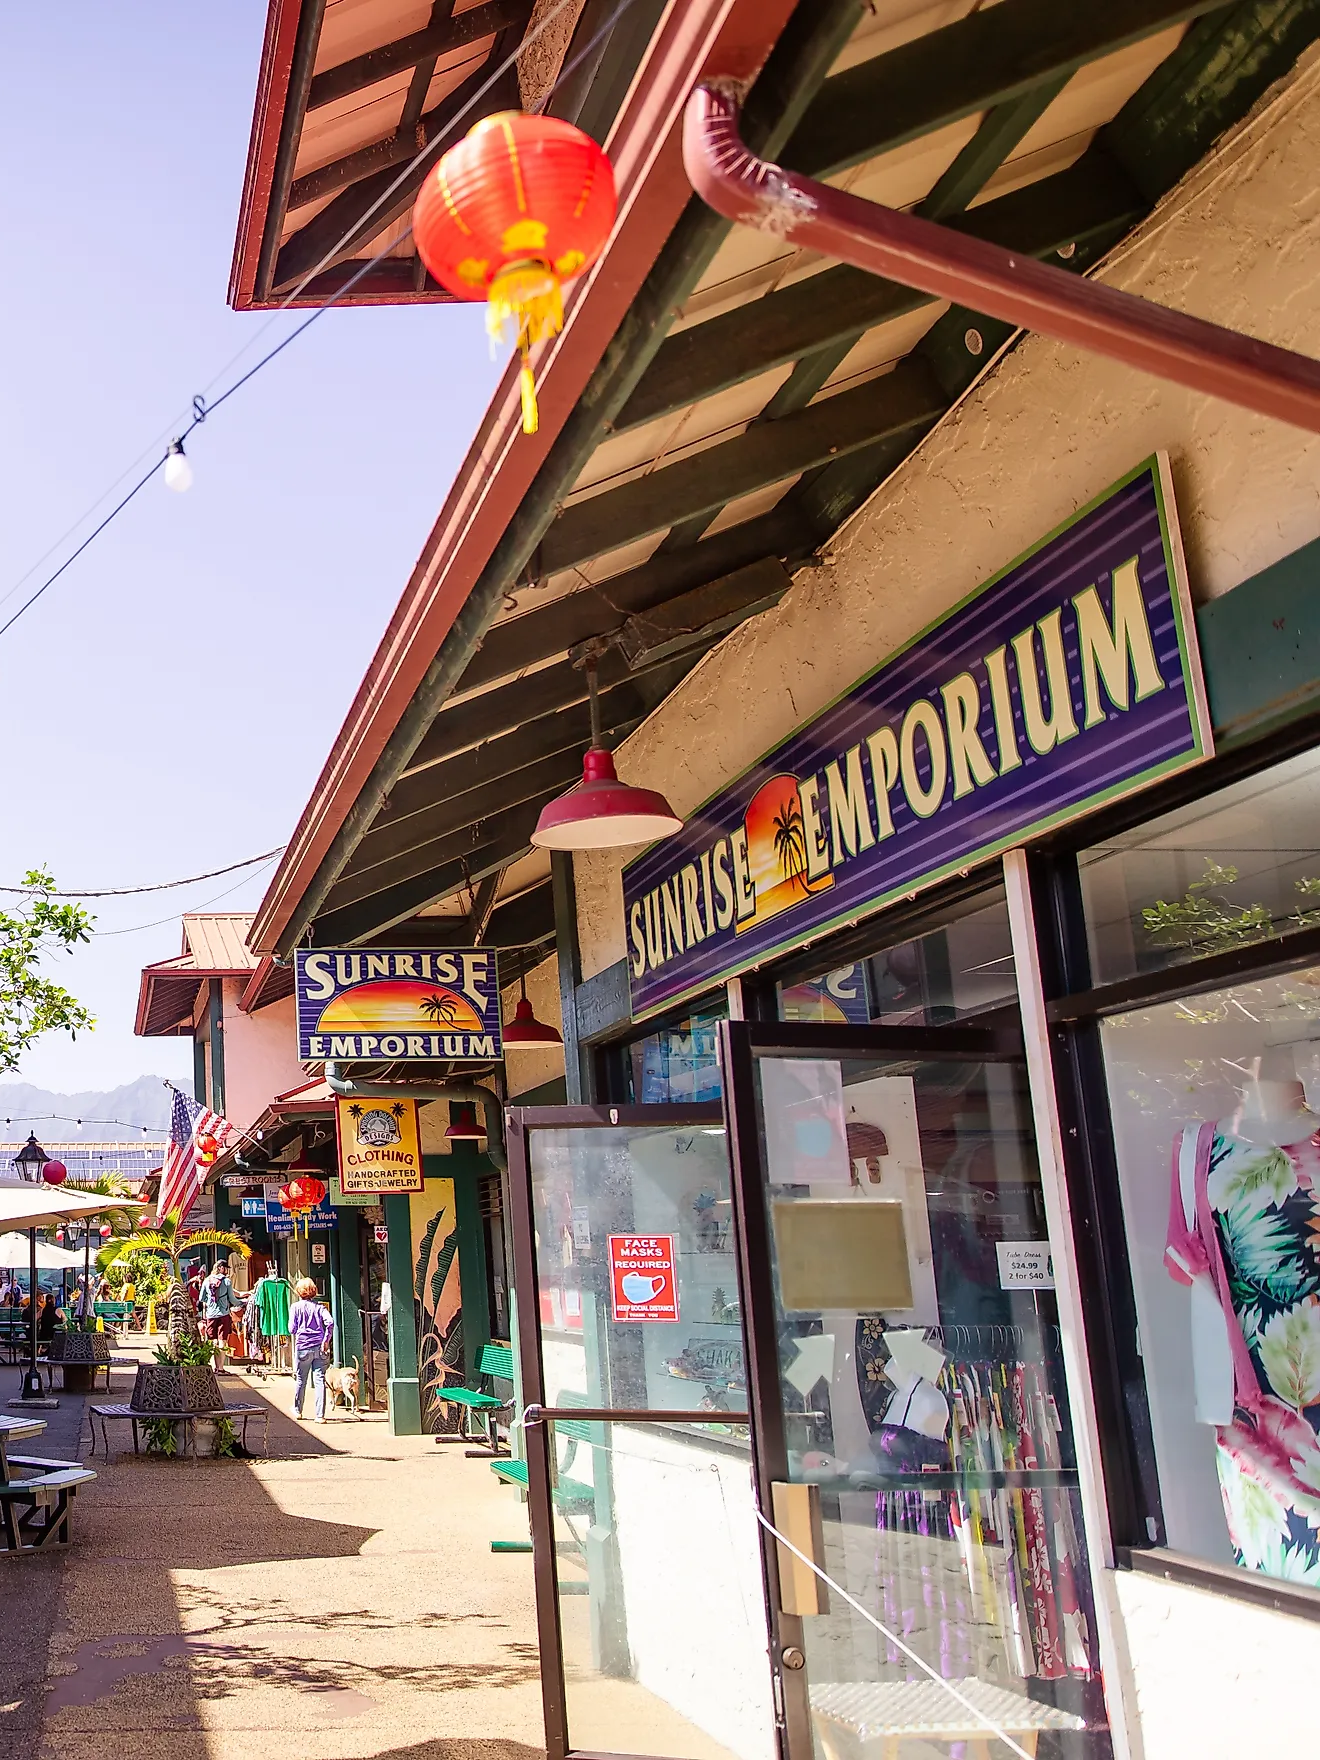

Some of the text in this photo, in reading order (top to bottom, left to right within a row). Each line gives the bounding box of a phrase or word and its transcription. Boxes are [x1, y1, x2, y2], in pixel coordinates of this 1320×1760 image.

[629, 554, 1166, 980] SUNRISE EMPORIUM
[304, 952, 488, 1014] SUNRISE
[308, 1034, 497, 1058] EMPORIUM
[347, 1149, 414, 1166] CLOTHING
[347, 1169, 417, 1179] HANDCRAFTED
[317, 1211, 337, 1220] Work
[624, 1240, 658, 1248] FACE
[621, 1248, 664, 1257] MASKS
[615, 1260, 671, 1269] REQUIRED
[1009, 1272, 1044, 1280] 2 for $40
[617, 1304, 675, 1312] KEEP SOCIAL DISTANCE
